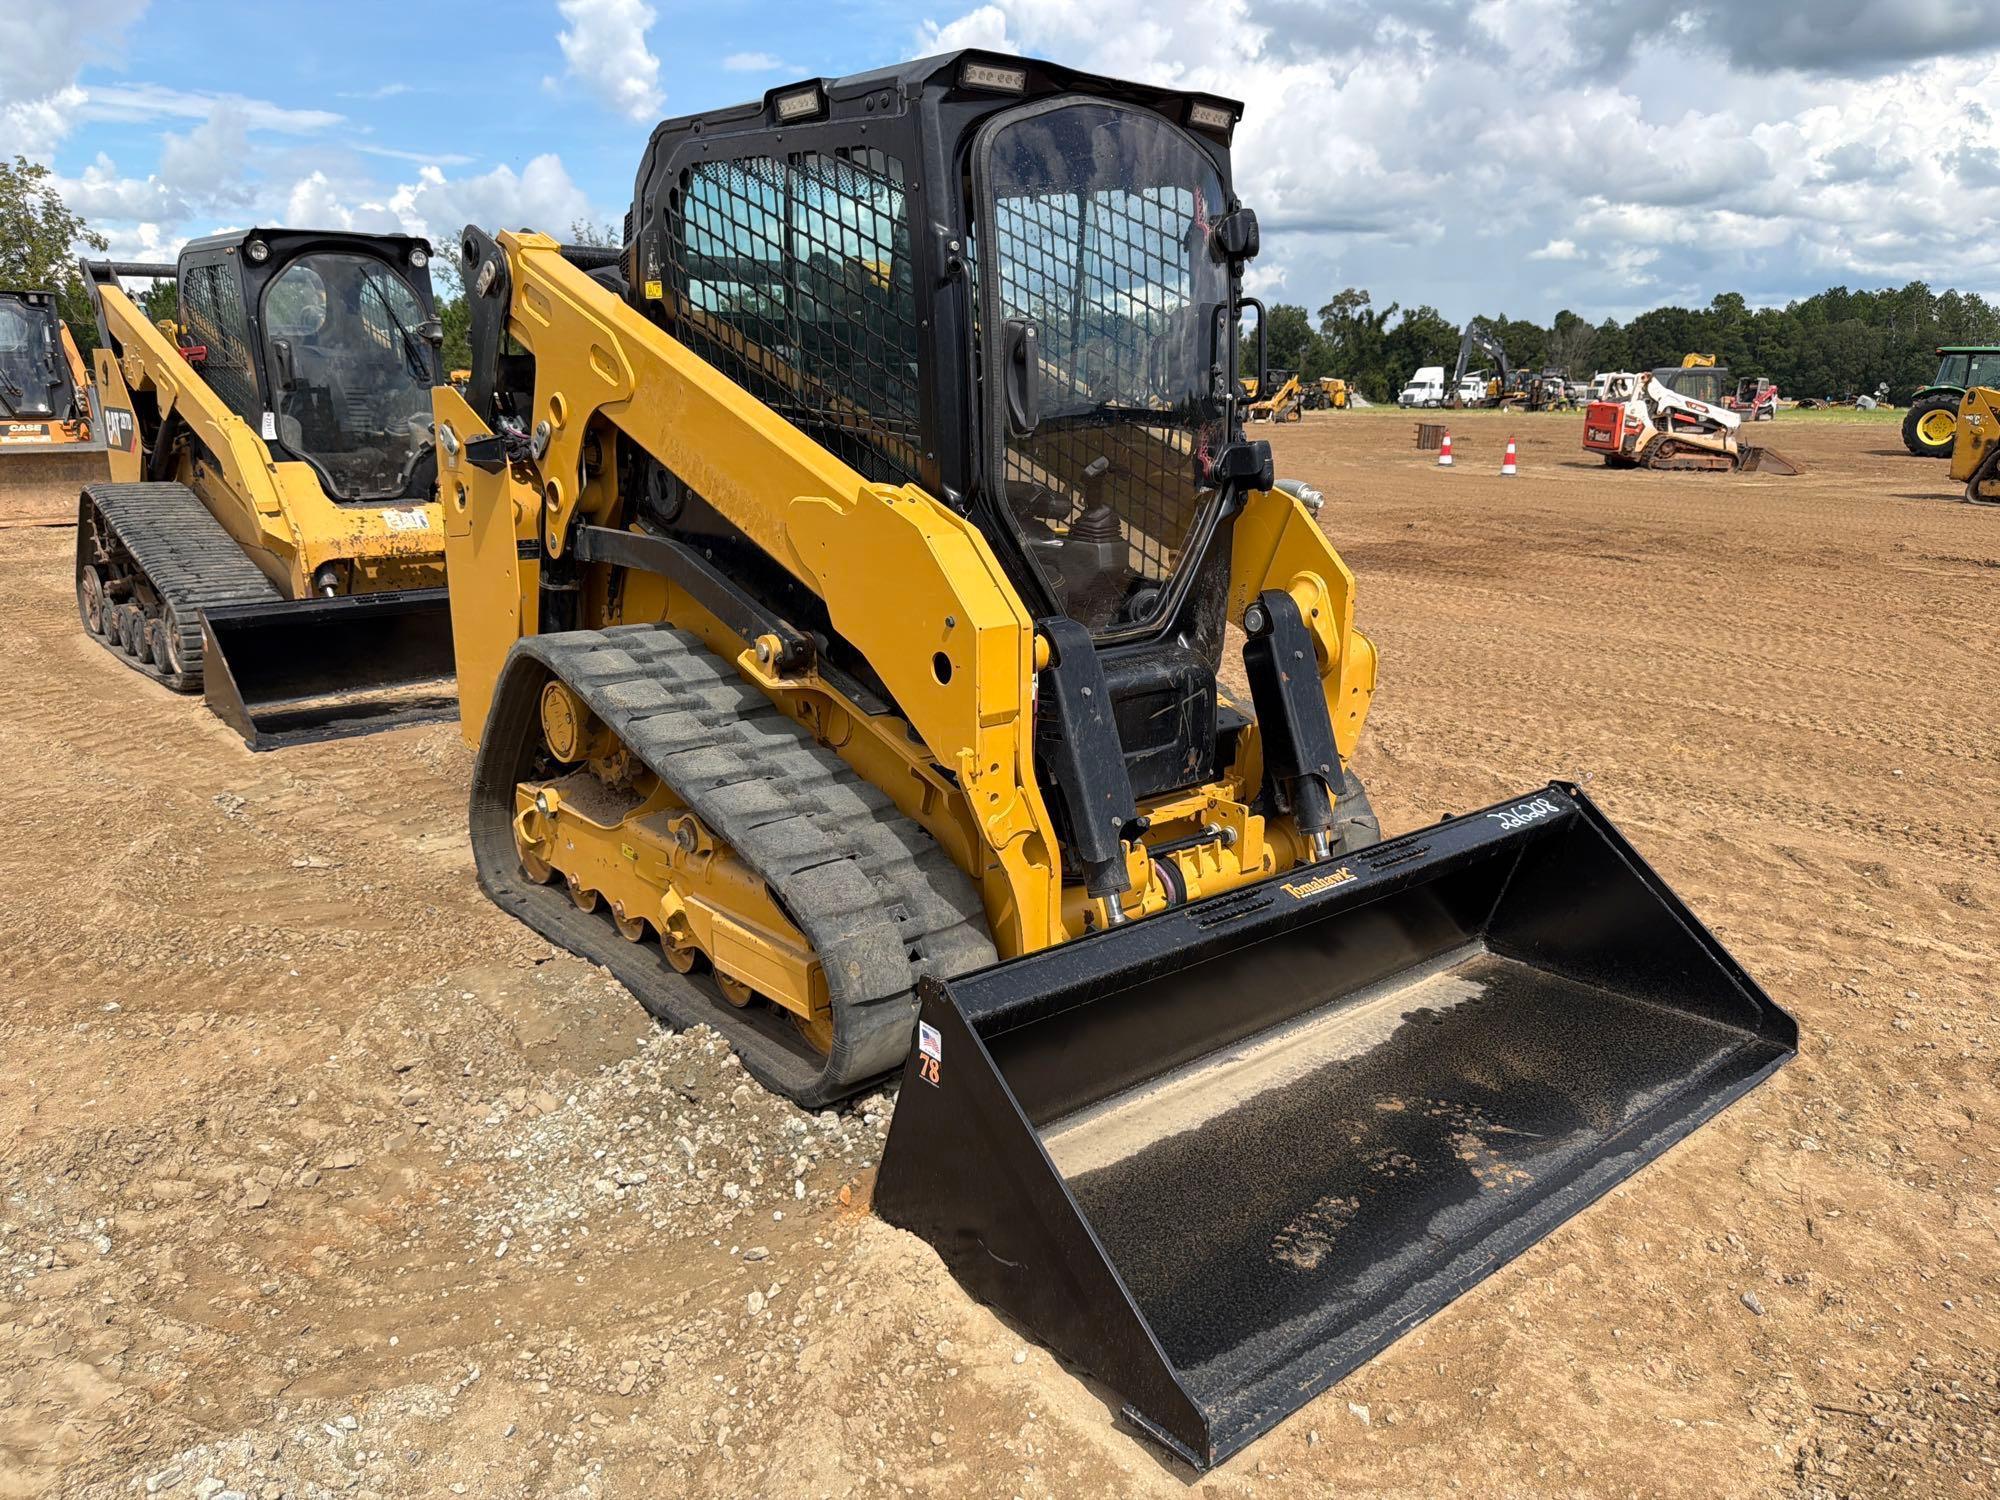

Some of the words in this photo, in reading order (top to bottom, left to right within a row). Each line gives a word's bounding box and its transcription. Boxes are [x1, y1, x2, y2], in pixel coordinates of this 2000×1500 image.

[9, 424, 42, 432] CASE
[105, 410, 122, 446] CAT
[1486, 798, 1560, 830] 226208
[919, 1052, 940, 1084] 78
